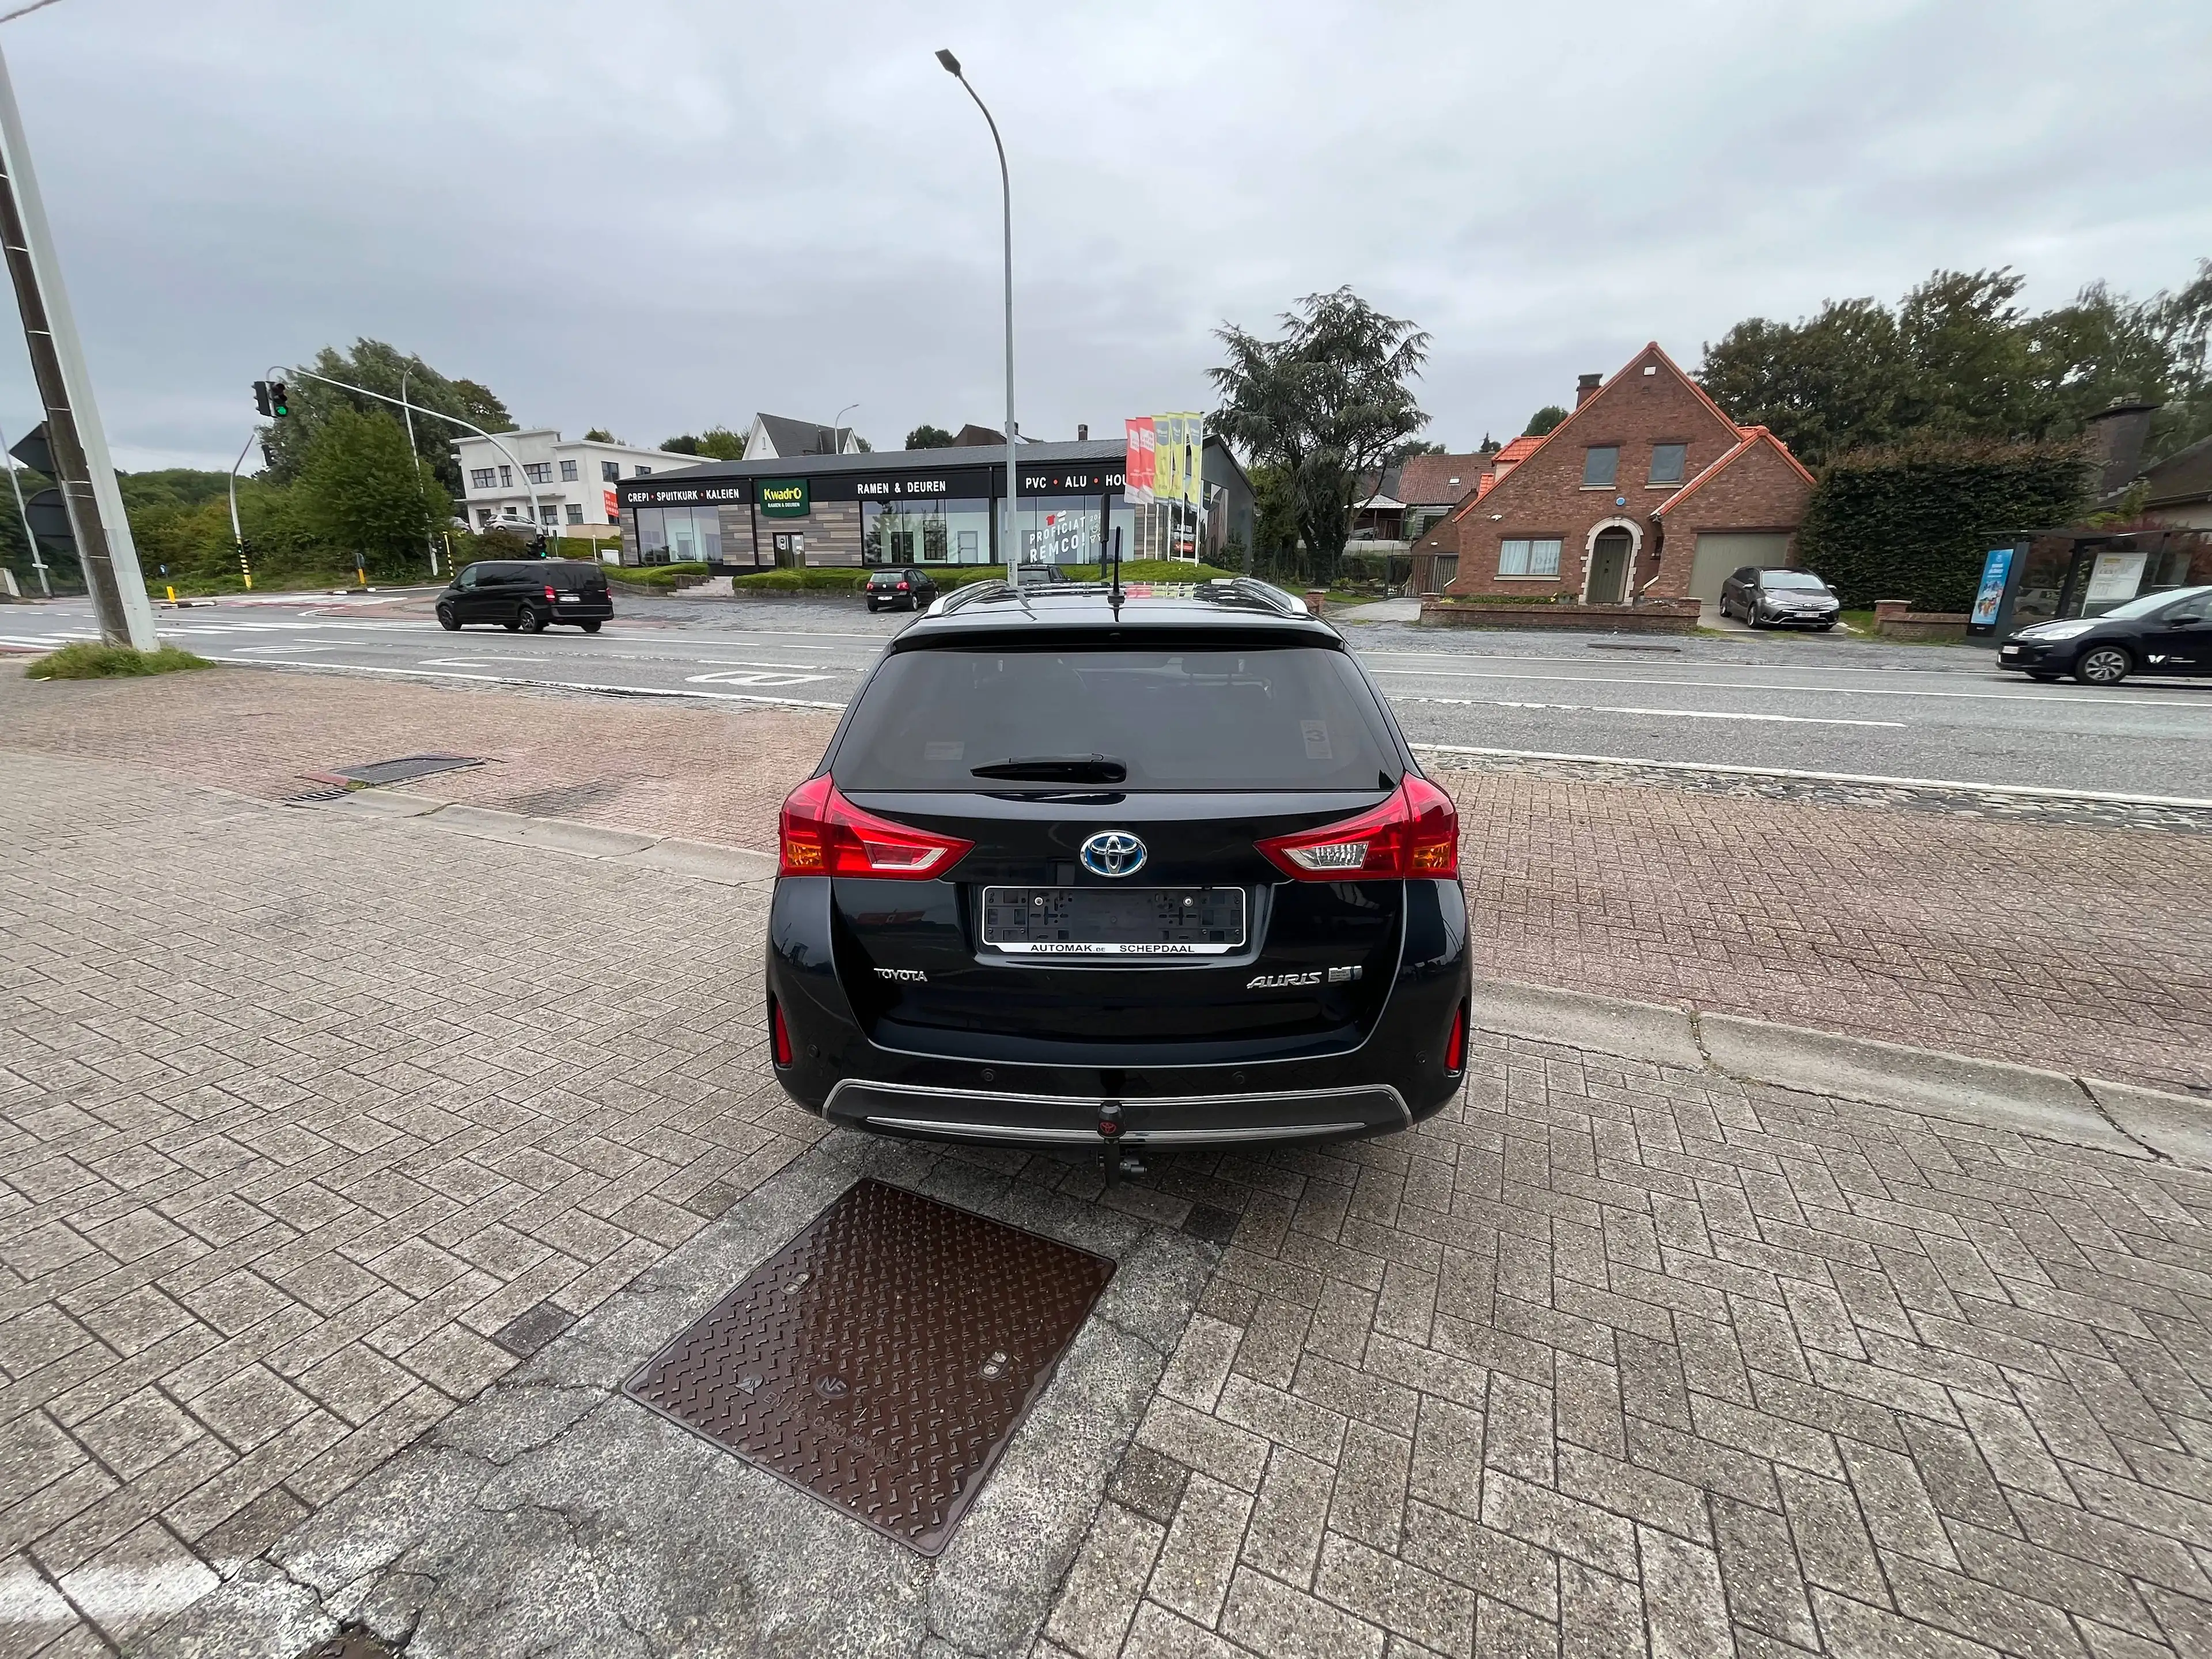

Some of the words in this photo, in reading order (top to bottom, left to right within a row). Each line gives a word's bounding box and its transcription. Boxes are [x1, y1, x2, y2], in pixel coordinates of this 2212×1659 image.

[857, 483, 889, 494] RAMEN
[894, 482, 902, 493] &
[907, 480, 946, 493] DEUREN
[1025, 476, 1046, 488] PVC
[1065, 475, 1087, 488] ALU
[627, 493, 649, 502] CREPI
[656, 490, 698, 501] SPUITKURK
[706, 488, 740, 499] KALEIEN
[1029, 516, 1086, 544] PROFICIAT
[1119, 945, 1195, 953] SCHEPDAAL
[873, 968, 928, 982] TOYOTA
[1246, 971, 1323, 990] AURIS
